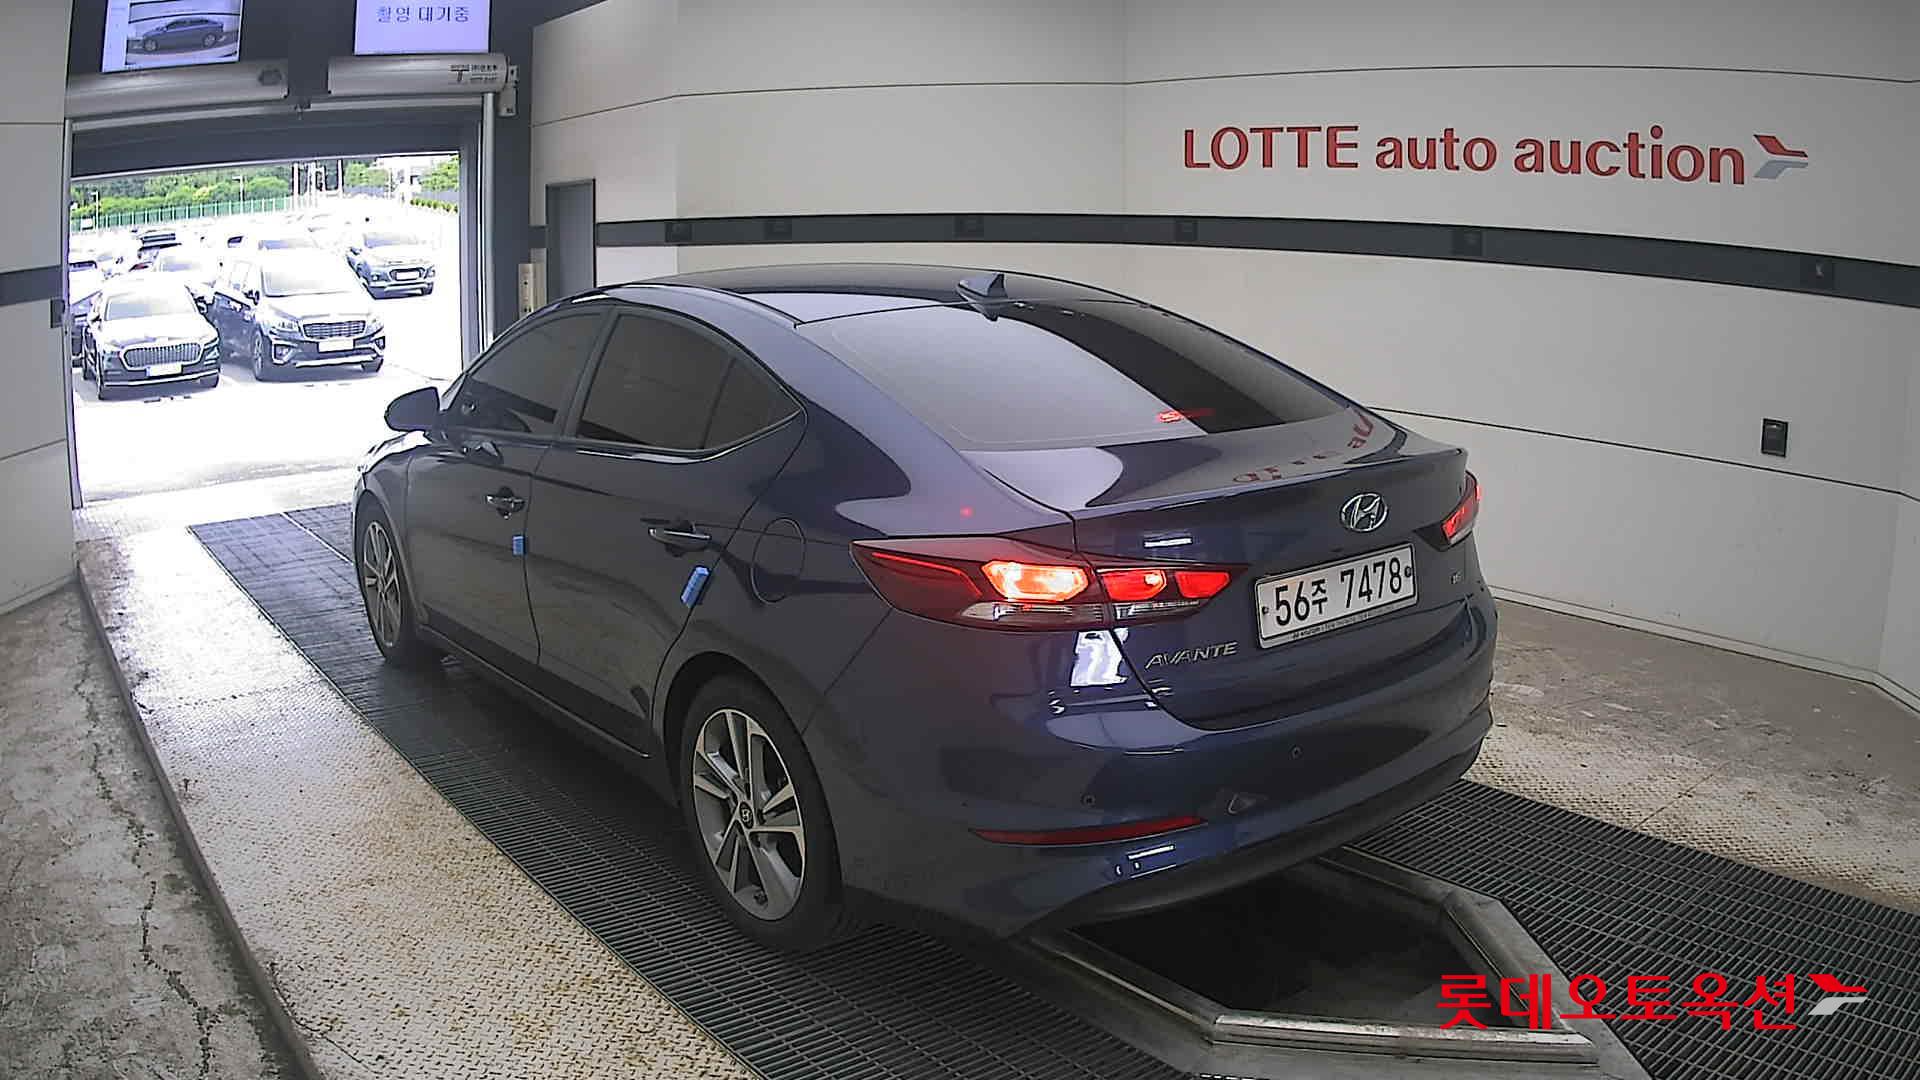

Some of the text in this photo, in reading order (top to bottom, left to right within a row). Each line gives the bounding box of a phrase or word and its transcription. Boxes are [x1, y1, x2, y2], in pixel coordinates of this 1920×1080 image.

[1184, 124, 1745, 184] LOTTE auto auction
[1274, 578, 1328, 626] 56주
[1340, 557, 1402, 609] 7478
[1143, 641, 1239, 670] AVANTE
